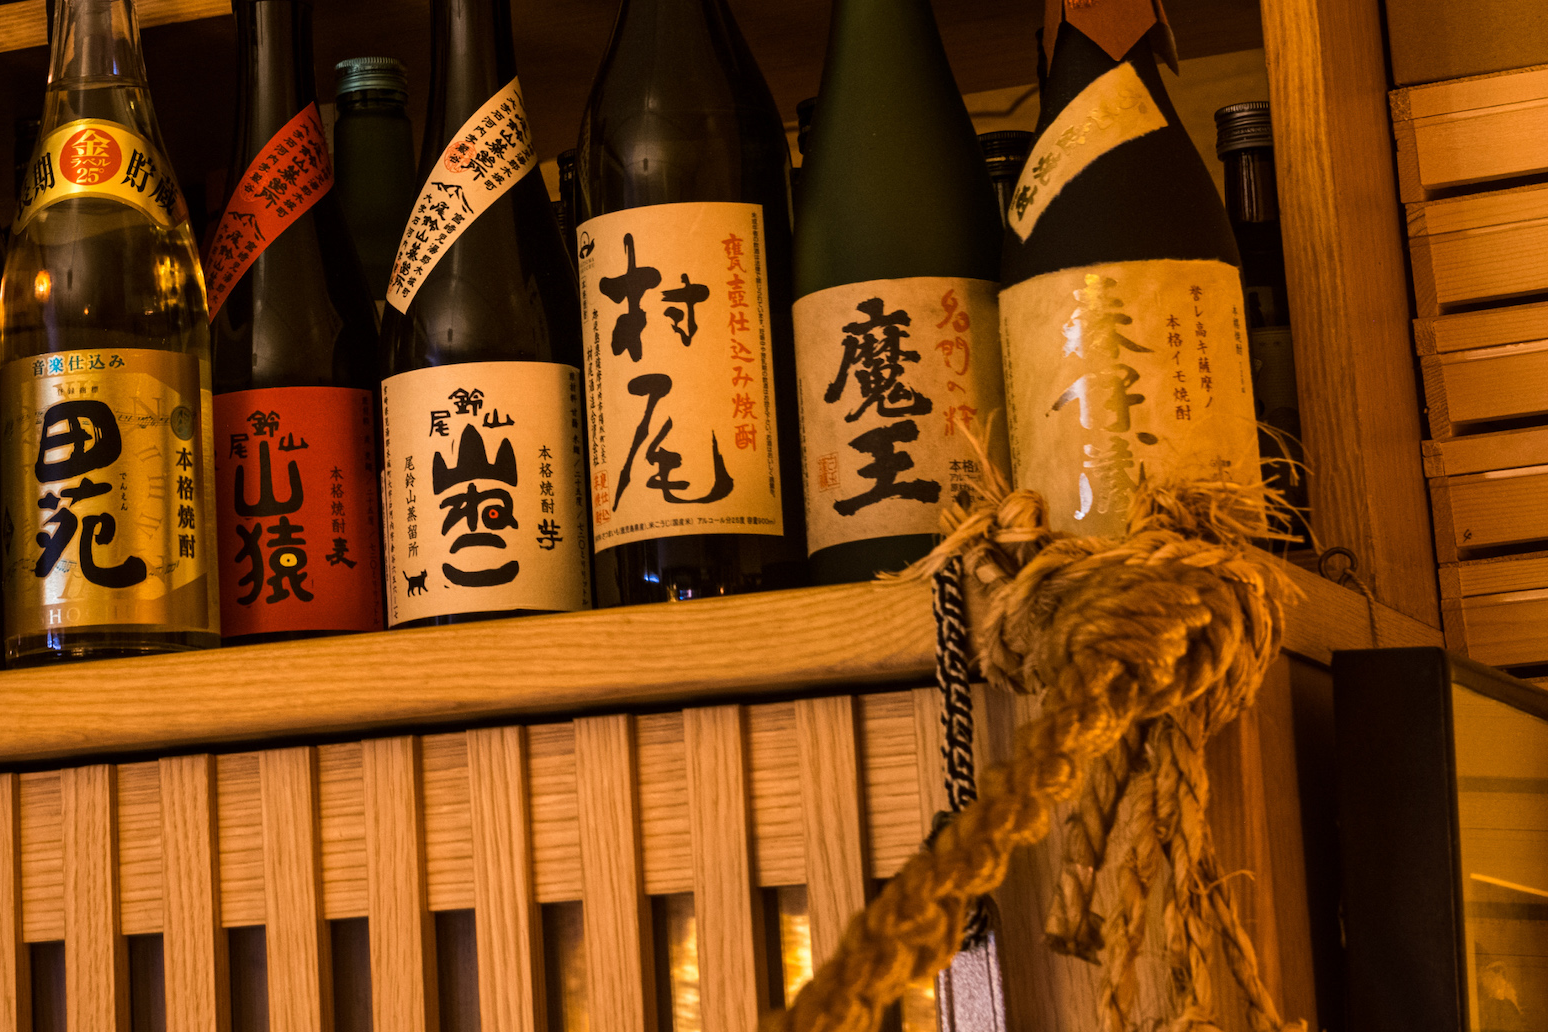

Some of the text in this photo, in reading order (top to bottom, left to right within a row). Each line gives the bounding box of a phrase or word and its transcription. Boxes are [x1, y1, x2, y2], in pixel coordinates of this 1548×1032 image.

[70, 157, 112, 168] ラベル
[72, 129, 111, 158] 金
[121, 148, 179, 217] 貯蔵
[32, 353, 126, 377] 音楽仕込み
[599, 232, 735, 512] 村尾
[824, 296, 941, 517] 魔王
[1165, 314, 1191, 421] 本格イモ焼酎
[34, 400, 147, 589] 田苑
[175, 447, 196, 560] 本格焼酎
[234, 440, 315, 606] 山猿
[329, 466, 346, 534] 本格焼酎
[403, 455, 419, 558] 尾鈴山蒸留所
[538, 445, 554, 514] 本格焼酎
